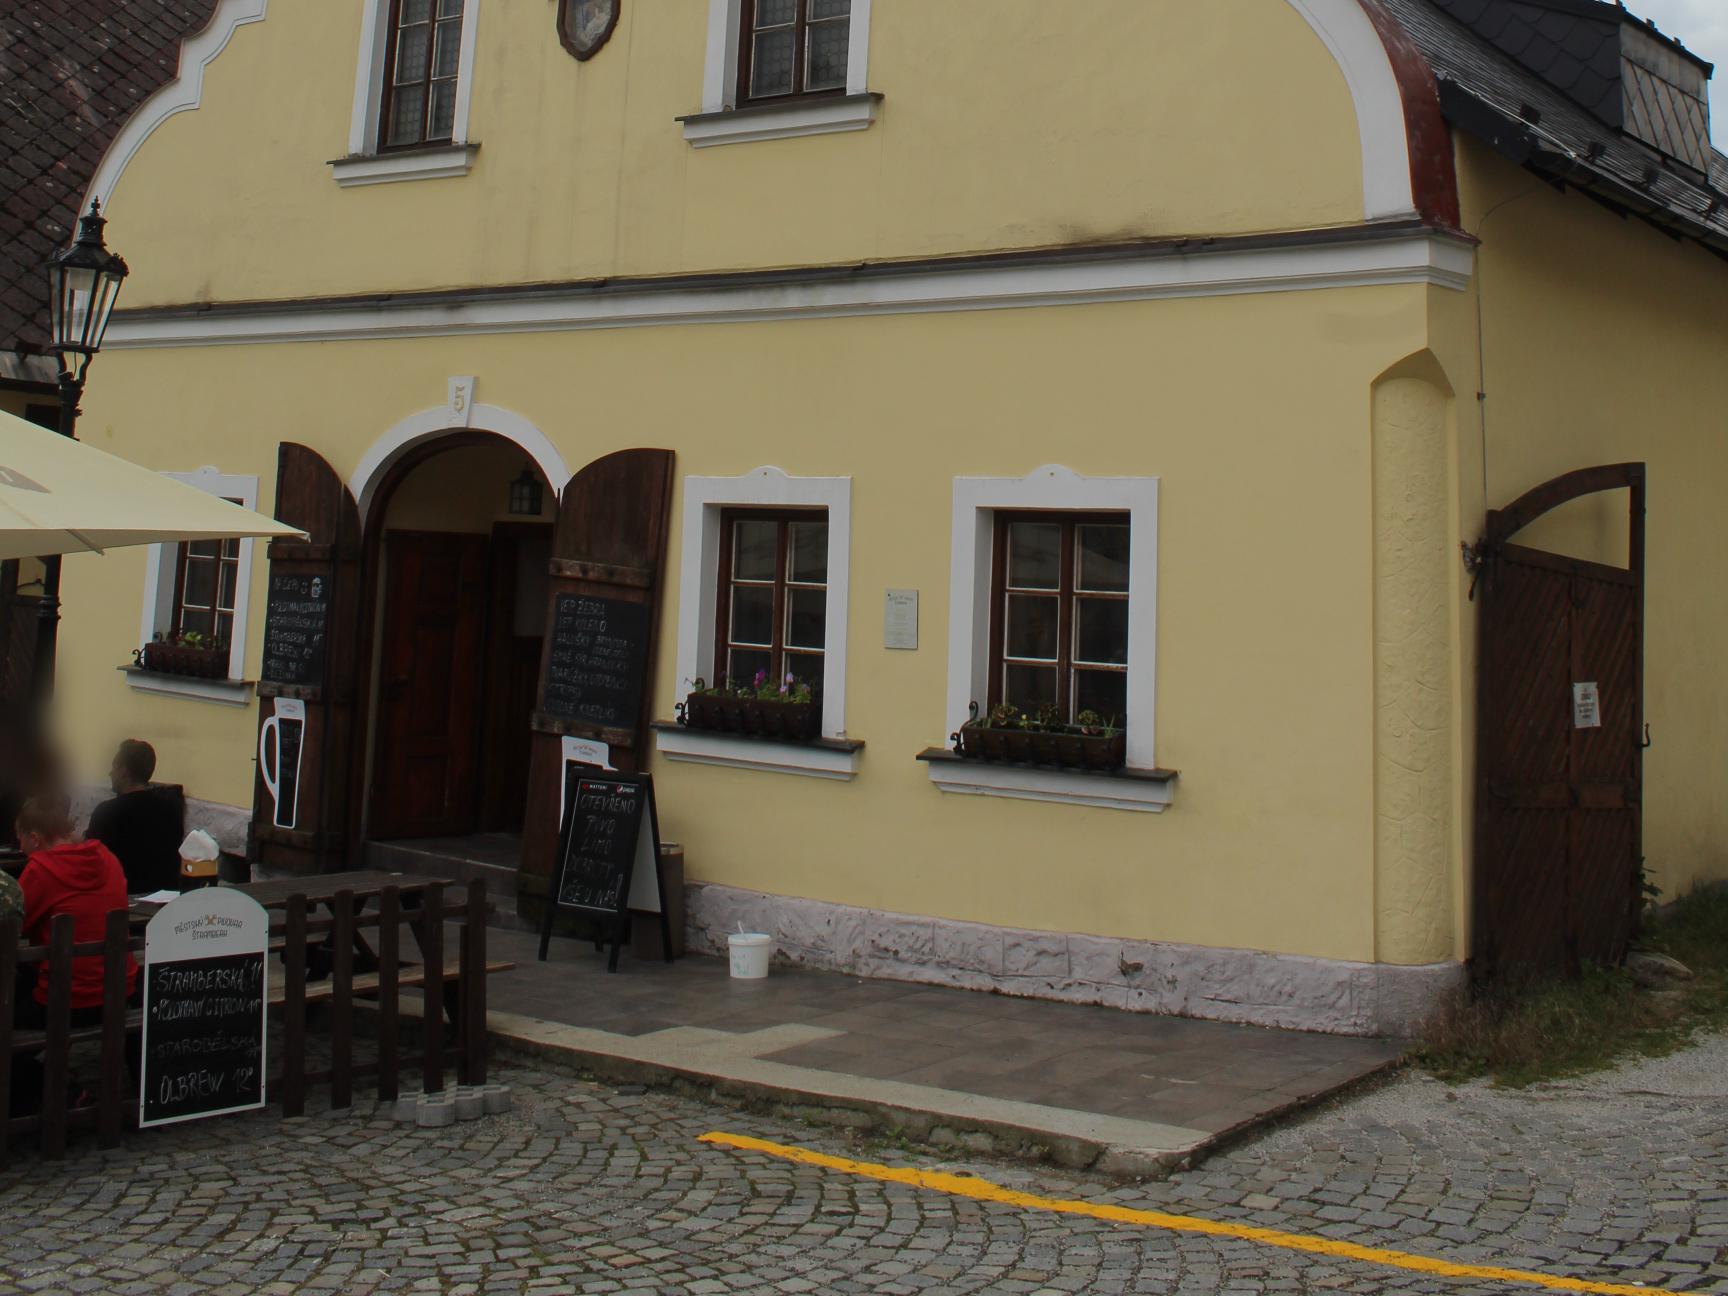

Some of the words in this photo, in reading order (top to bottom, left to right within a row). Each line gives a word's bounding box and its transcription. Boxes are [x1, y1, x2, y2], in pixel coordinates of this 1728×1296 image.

[580, 793, 636, 815] OTEVŘENO
[586, 814, 616, 834] PIVO
[581, 837, 612, 855] LIMO
[157, 958, 248, 993] ŠTRAMBERSKÁ
[160, 1069, 225, 1104] OLBREW
